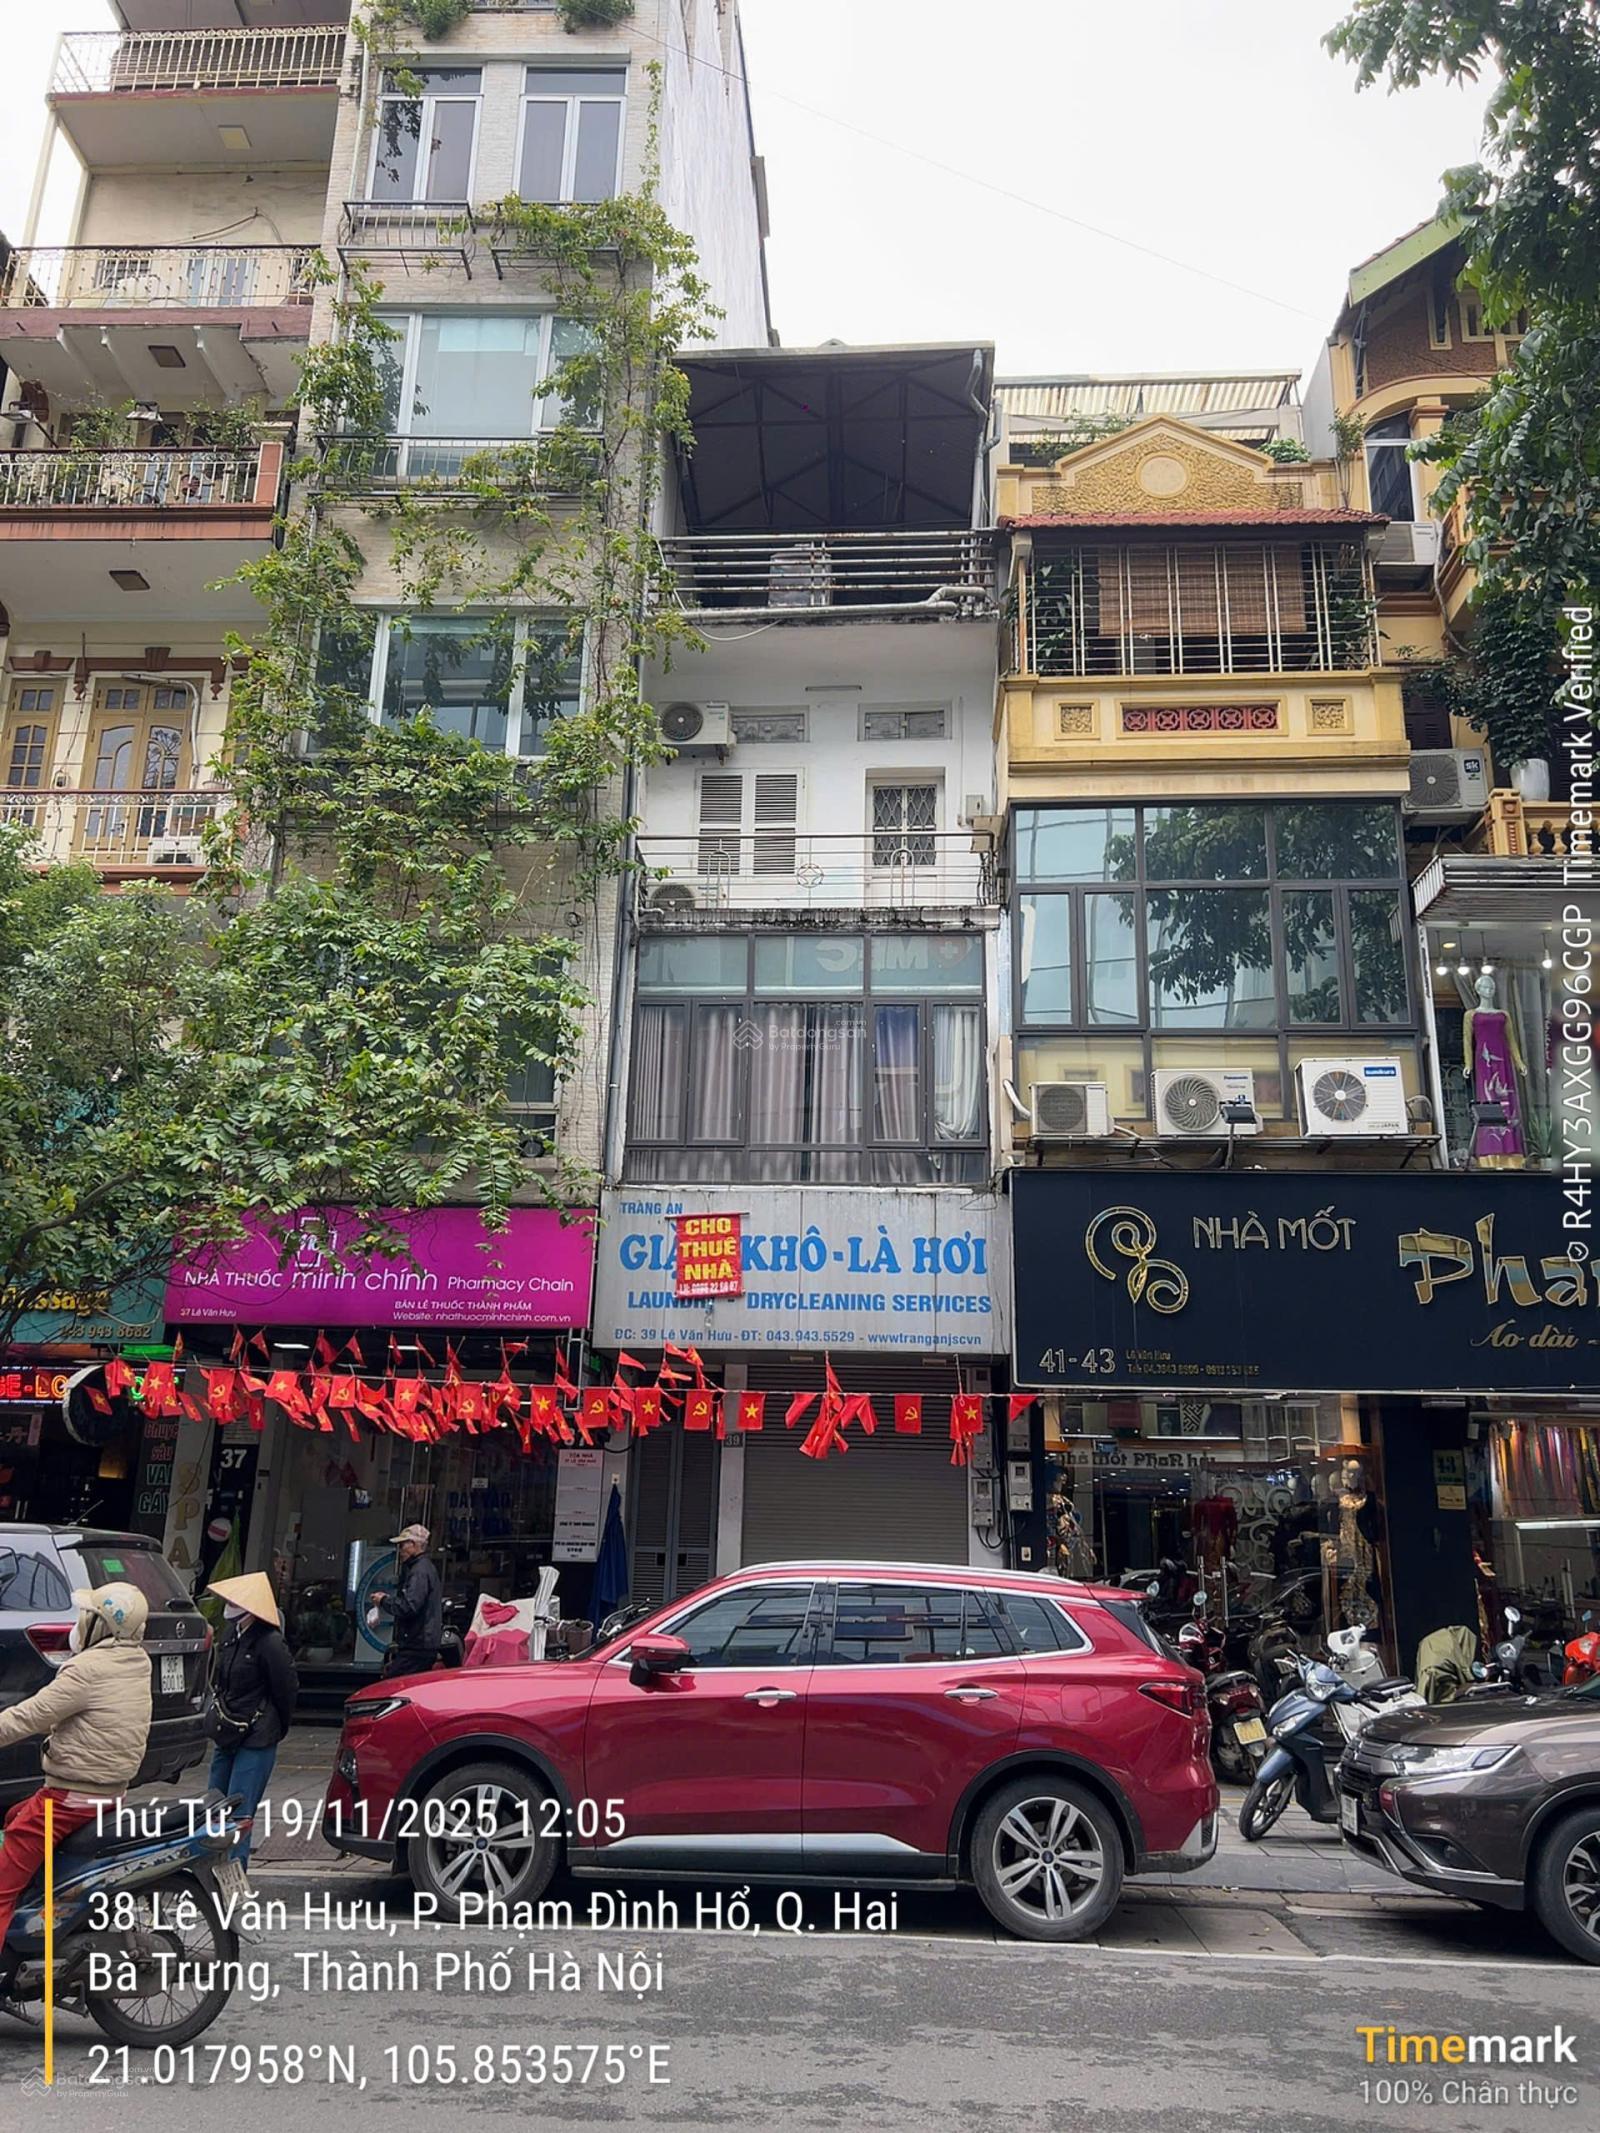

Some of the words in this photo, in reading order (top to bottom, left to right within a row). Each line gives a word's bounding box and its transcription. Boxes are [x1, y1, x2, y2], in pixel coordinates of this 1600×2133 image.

[666, 1202, 683, 1214] AN
[685, 1217, 731, 1235] CHO
[1193, 1211, 1269, 1249] NHÀ
[1278, 1205, 1356, 1250] MỐT
[680, 1237, 737, 1257] THUÊ
[912, 1230, 987, 1274] HƠI
[684, 1259, 733, 1280] NHÀ
[185, 1268, 219, 1286] NHÀ
[226, 1268, 283, 1287] THUỐC
[292, 1268, 356, 1289] minh
[364, 1267, 437, 1290] chính
[447, 1276, 524, 1293] Pharmacy
[529, 1277, 574, 1292] Chain
[747, 1292, 885, 1311] DRYCLEANING
[892, 1294, 992, 1313] SERVICES
[393, 1312, 434, 1320] Website:
[436, 1313, 571, 1323] nhathuocminhchinh.com.vn
[88, 1325, 113, 1338] 943
[641, 1330, 657, 1340] 39
[661, 1328, 675, 1341] Lê
[680, 1329, 703, 1341] Văn
[766, 1331, 854, 1343] 043.943.5529
[1529, 1325, 1581, 1348] dài
[220, 1448, 247, 1468] 37
